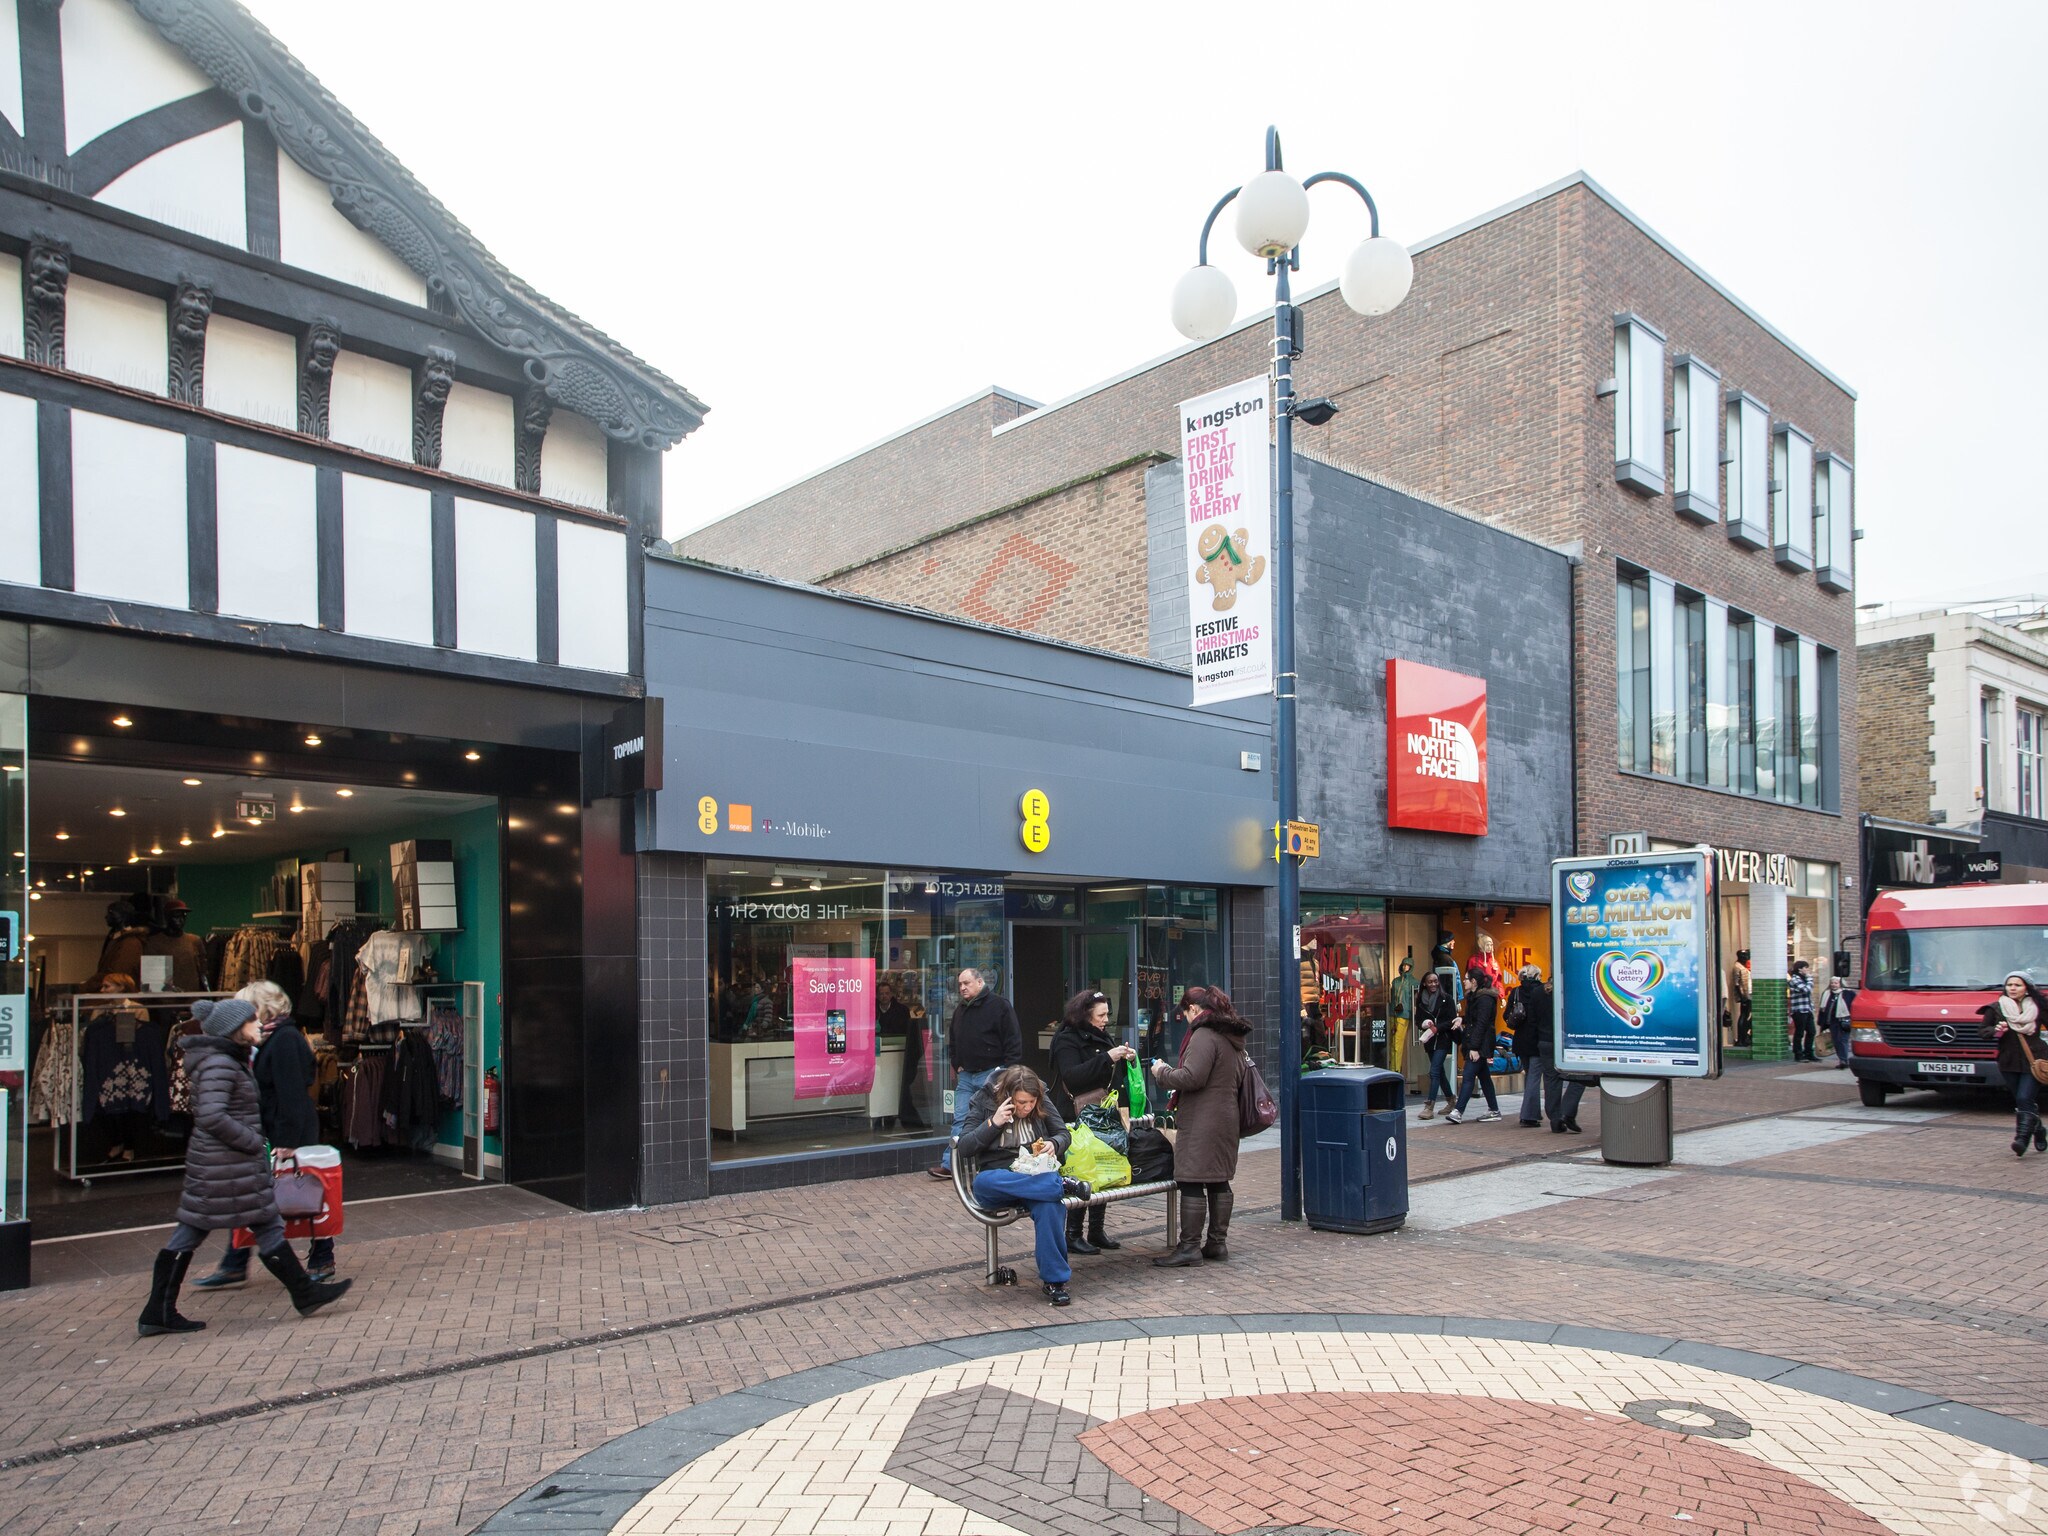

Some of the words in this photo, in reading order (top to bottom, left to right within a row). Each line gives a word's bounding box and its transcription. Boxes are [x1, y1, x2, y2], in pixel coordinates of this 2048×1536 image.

[1188, 427, 1228, 456] FIRST
[1188, 453, 1206, 472] TO
[1210, 442, 1236, 466] EAT
[1189, 460, 1234, 490] DRINK
[1189, 489, 1200, 507] &
[1205, 481, 1224, 502] BE
[1190, 493, 1242, 524] MERRY
[1195, 616, 1239, 638] FESTIVE
[1196, 625, 1260, 652] CHRISTMAS
[1197, 643, 1249, 666] MARKETS
[1429, 717, 1456, 741] THE
[613, 735, 644, 760] TOPMAN
[1407, 733, 1456, 761] NORTH
[729, 823, 750, 832] orange
[1606, 859, 1640, 867] JCDecaux
[1718, 849, 1761, 884] IVER
[1968, 859, 1999, 872] wallis
[1605, 889, 1650, 903] OVER
[1567, 905, 1600, 923] £15
[1604, 902, 1692, 922] MILLION
[1588, 925, 1607, 938] TO
[1610, 925, 1629, 938] BE
[1632, 925, 1669, 937] WON
[809, 979, 836, 994] Save
[838, 978, 862, 993] £109
[1922, 1063, 1948, 1072] YN58
[1950, 1064, 1971, 1073] HZT
